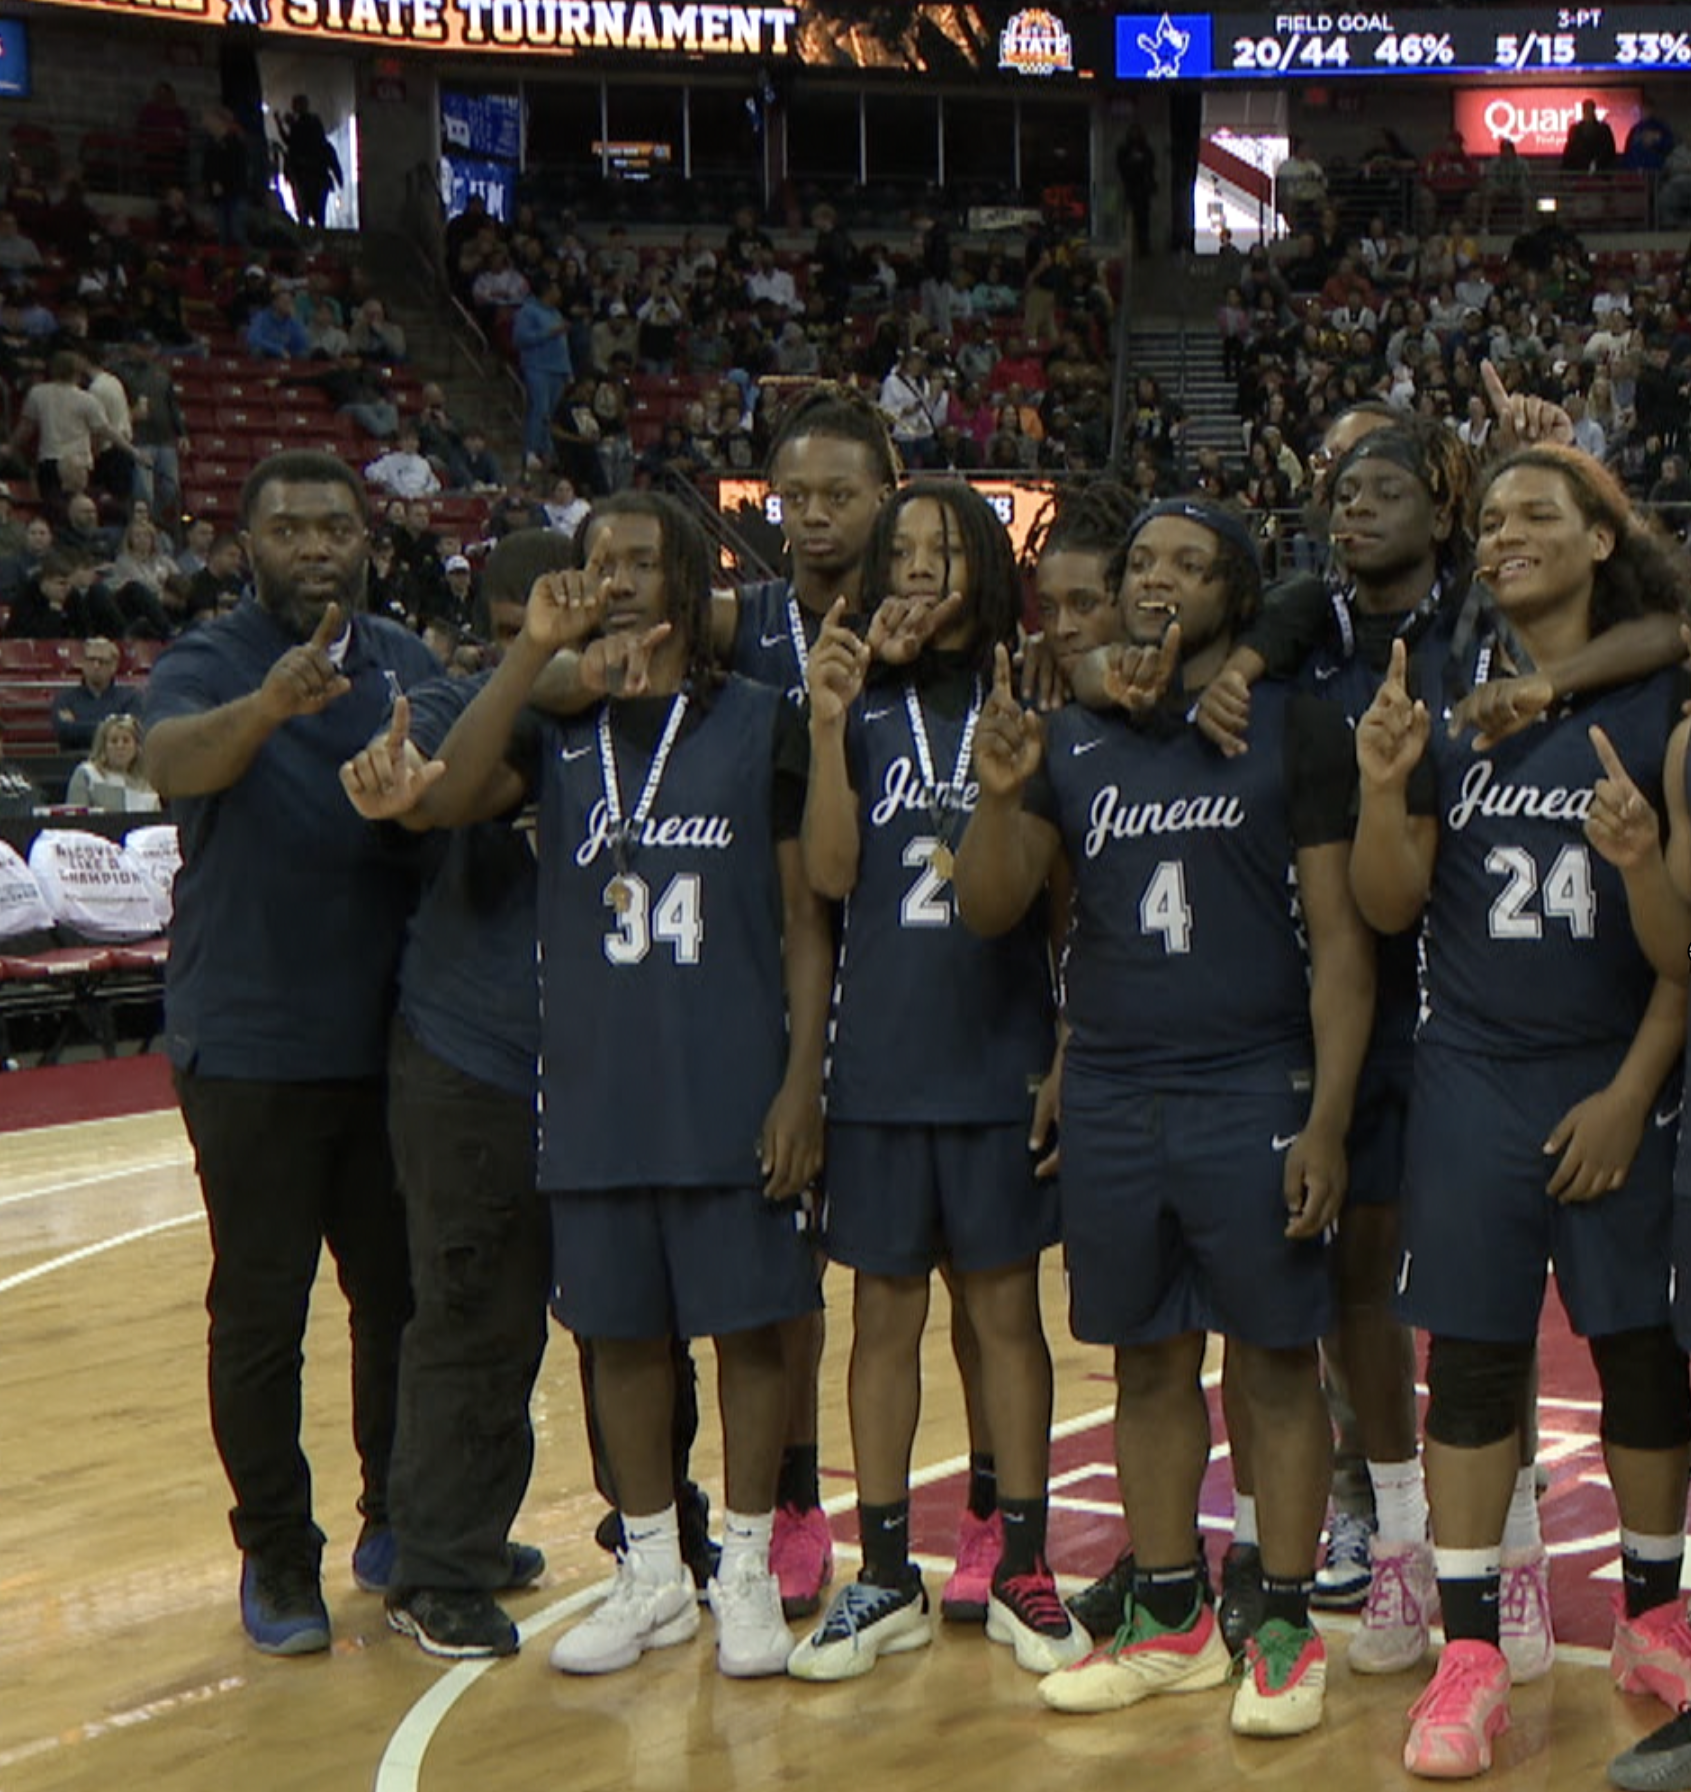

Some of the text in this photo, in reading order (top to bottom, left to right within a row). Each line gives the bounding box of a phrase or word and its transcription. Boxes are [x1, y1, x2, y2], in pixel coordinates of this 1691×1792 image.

[287, 0, 443, 39] STATE
[457, 0, 796, 54] TOURNAMENT
[1233, 34, 1350, 70] 20/44
[1374, 32, 1454, 66] 46%
[1495, 30, 1575, 69] 5/15
[1616, 32, 1691, 64] 33%
[1276, 13, 1394, 32] FIELD GOAL
[1557, 8, 1602, 28] 3-PT
[1484, 100, 1608, 142] Quar
[871, 756, 979, 827] June
[1085, 785, 1245, 858] Juneau
[1447, 760, 1597, 831] Junea
[575, 799, 734, 866] Jneau
[901, 835, 959, 927] 2
[1139, 859, 1192, 955] 4
[1484, 843, 1597, 939] 24
[603, 873, 704, 964] 34
